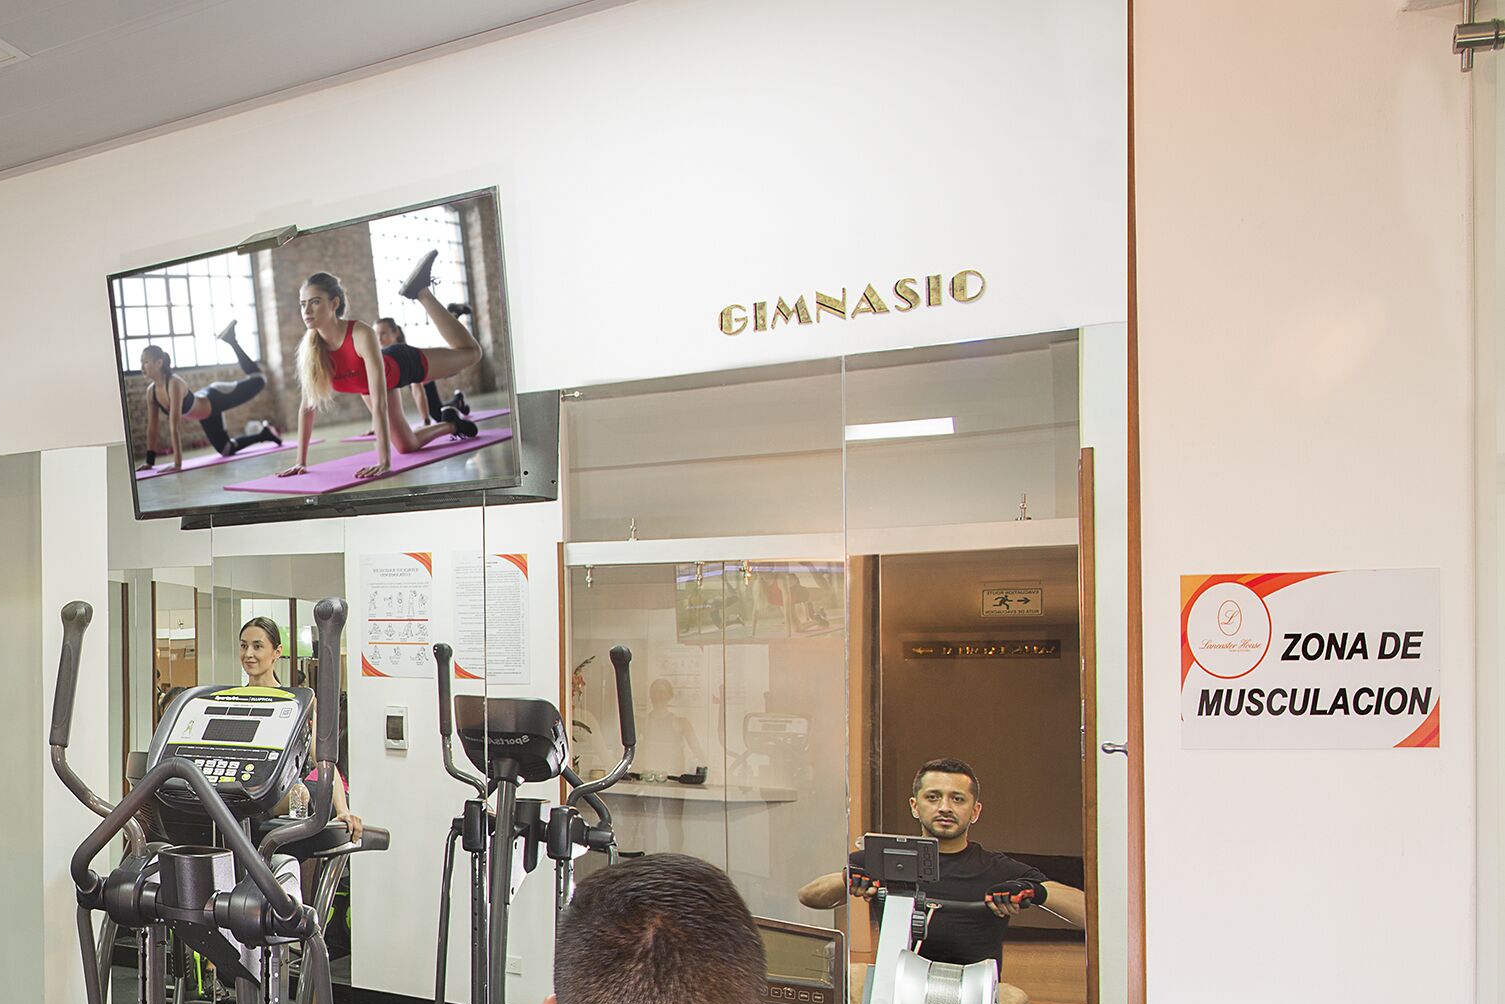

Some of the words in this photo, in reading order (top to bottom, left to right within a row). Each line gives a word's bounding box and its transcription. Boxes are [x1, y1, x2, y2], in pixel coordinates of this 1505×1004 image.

[718, 269, 986, 336] GIMNASIO
[1281, 632, 1369, 661] ZONA
[1377, 631, 1424, 660] DE
[1197, 687, 1432, 716] MUSCULACION
